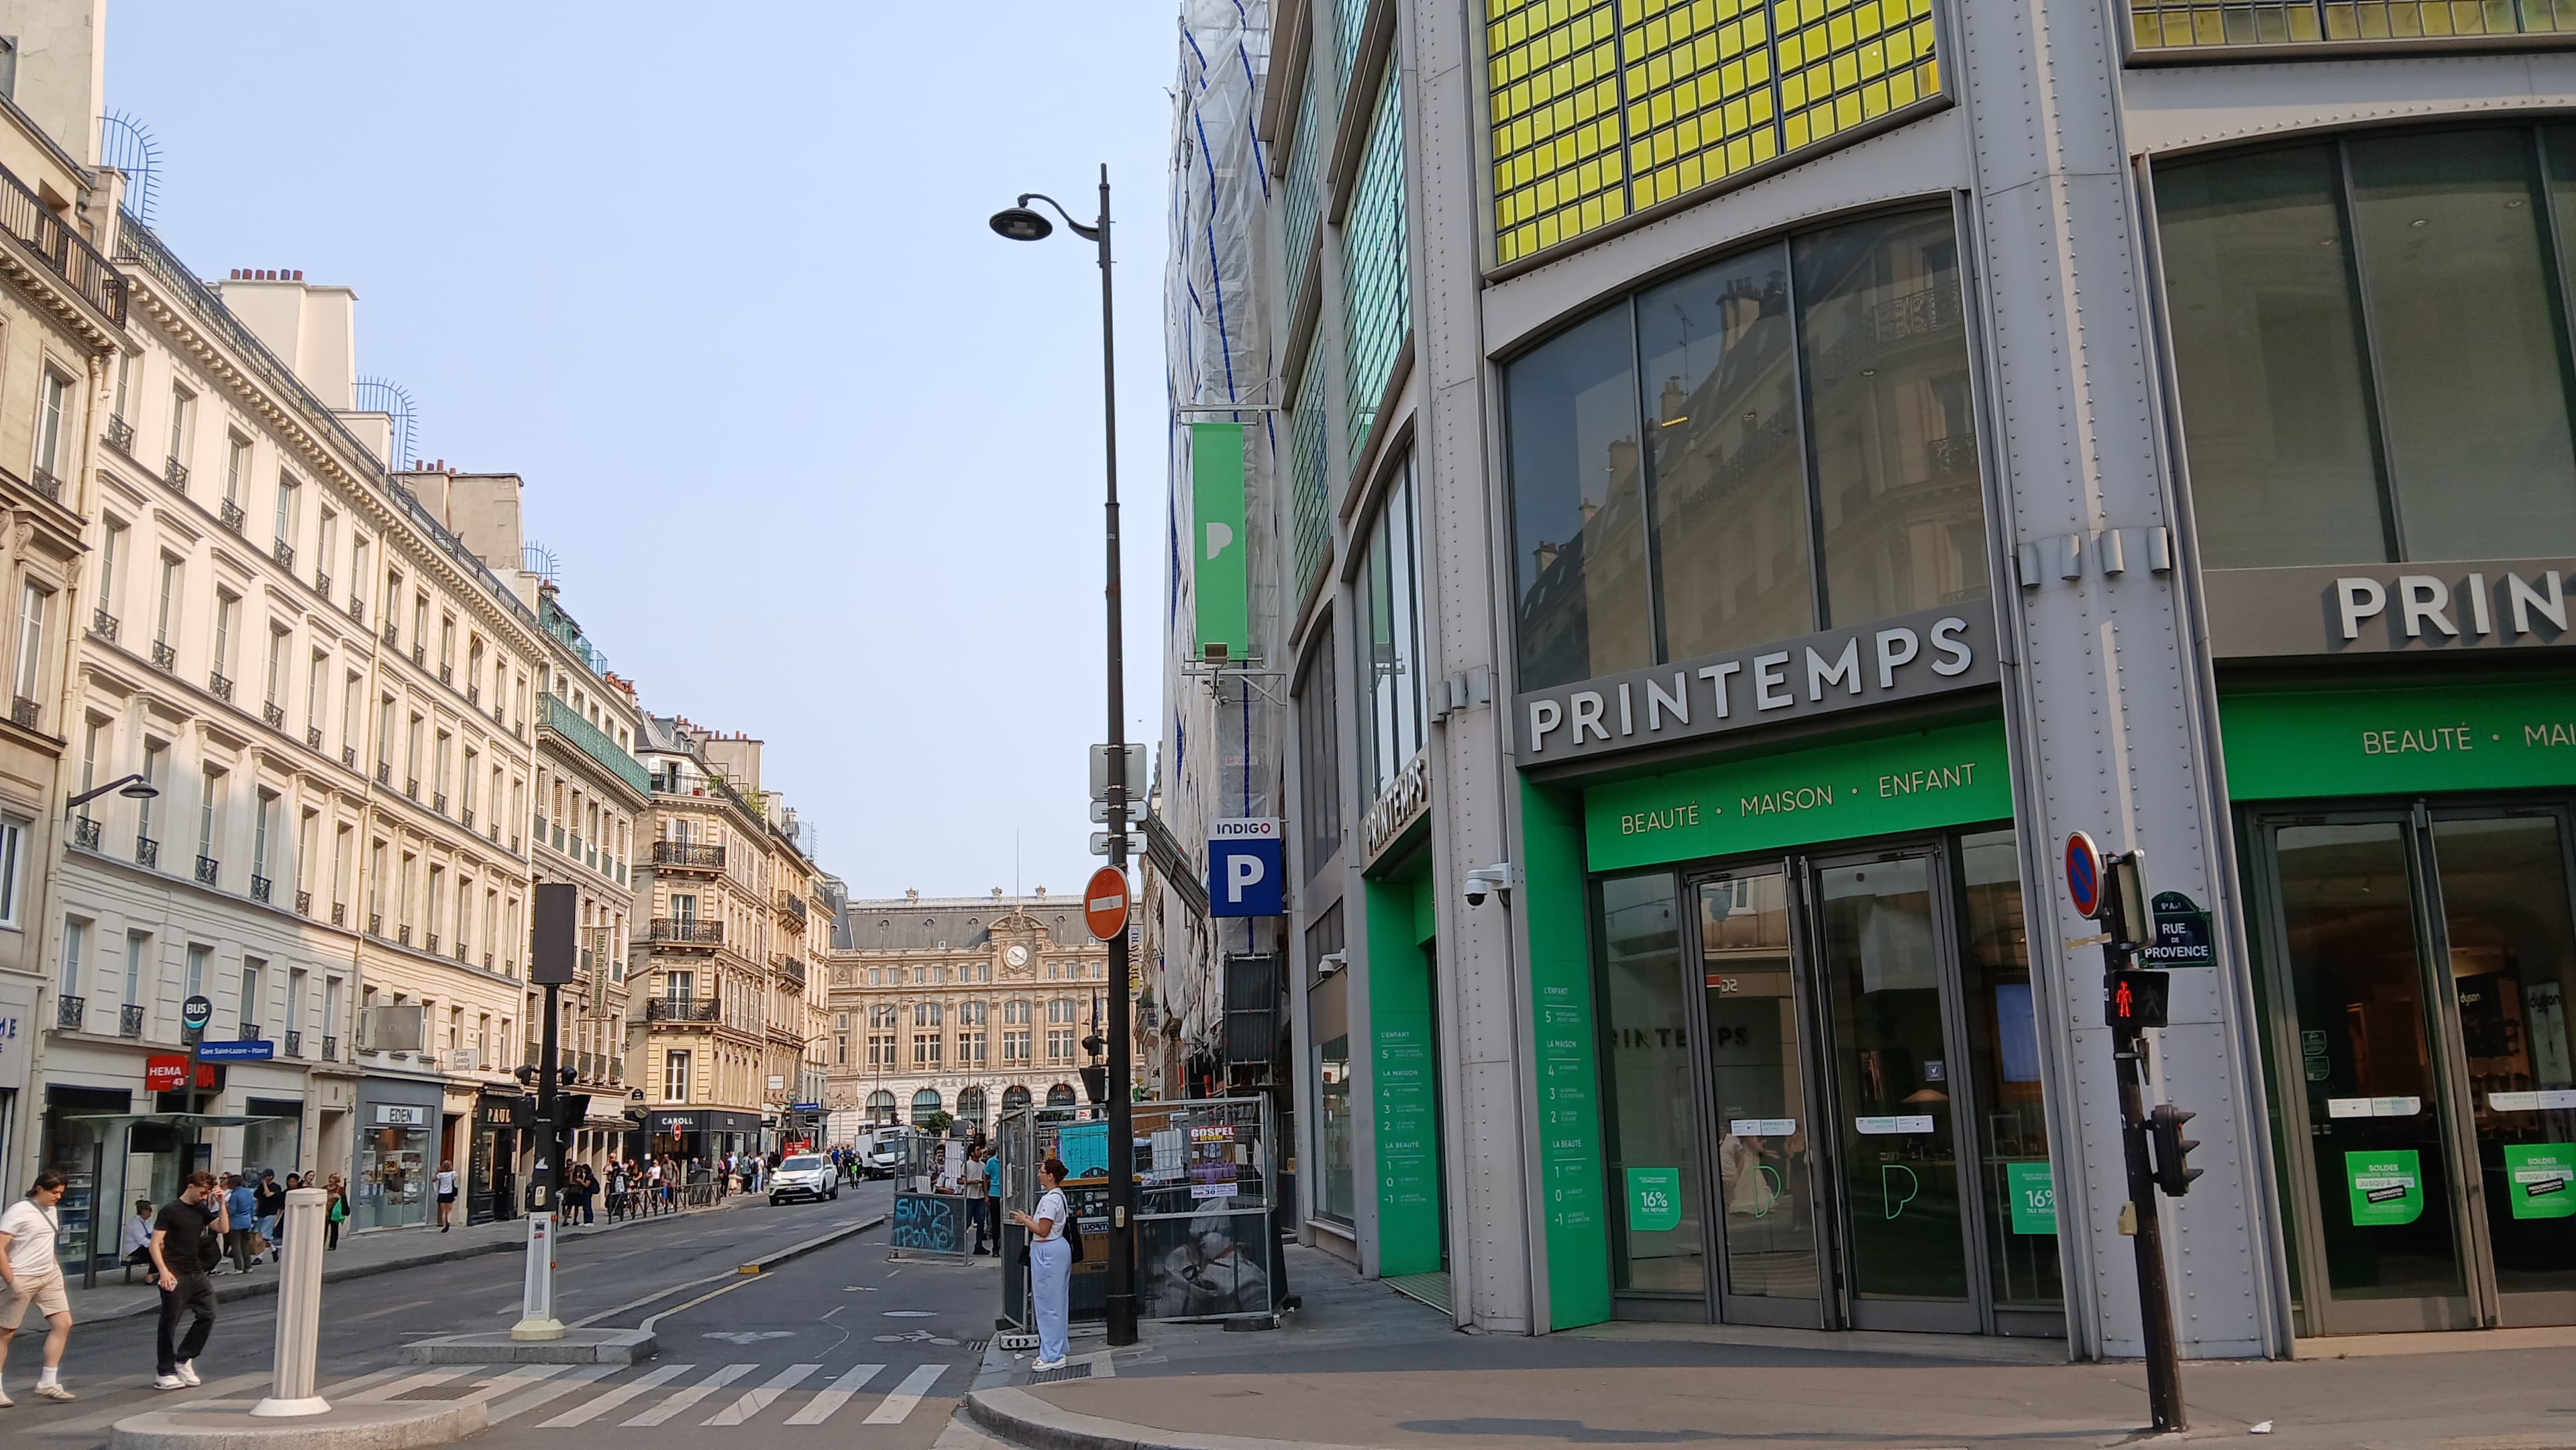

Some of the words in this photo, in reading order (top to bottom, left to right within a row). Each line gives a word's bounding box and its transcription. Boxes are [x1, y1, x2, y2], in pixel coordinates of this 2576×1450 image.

[2337, 570, 2568, 639] PRIN
[1529, 617, 1974, 753] PRINTEMPS
[2363, 721, 2473, 756] BEAUTÉ
[1621, 800, 1700, 836] BEAUTÉ
[1740, 784, 1833, 818] MAISON
[1879, 762, 1976, 799] ENFANT
[1366, 759, 1426, 856] PRINTEMPS
[1217, 823, 1271, 834] INDIGO
[1226, 854, 1265, 902] P
[2162, 923, 2187, 934] RUE
[2145, 945, 2209, 958] PROVENCE
[2460, 992, 2481, 1006] dyson
[186, 1003, 207, 1014] BUS
[1546, 1011, 1551, 1023] 5
[1382, 1049, 1388, 1059] 5
[149, 1067, 182, 1076] HEMA
[1548, 1064, 1554, 1077] 4
[172, 1078, 184, 1086] 43
[1383, 1088, 1390, 1097] 4
[1550, 1088, 1555, 1100] 3
[1384, 1104, 1391, 1114] 3
[389, 1108, 413, 1123] EDEN
[487, 1108, 511, 1123] PAUL
[661, 1117, 694, 1125] CAROLL
[1551, 1110, 1556, 1123] 2
[1191, 1127, 1234, 1137] GOSPEL
[1384, 1121, 1391, 1131] 2
[1561, 1139, 1582, 1148] BEAUTÉ
[1387, 1161, 1391, 1170] 1
[2528, 1157, 2557, 1165] SOLDES
[1555, 1166, 1560, 1178] 1
[2369, 1163, 2399, 1172] SOLDES
[1386, 1178, 1393, 1187] 0
[1384, 1194, 1393, 1203] -1
[1555, 1189, 1562, 1202] 0
[1641, 1191, 1668, 1207] 16%
[1555, 1212, 1562, 1225] -1
